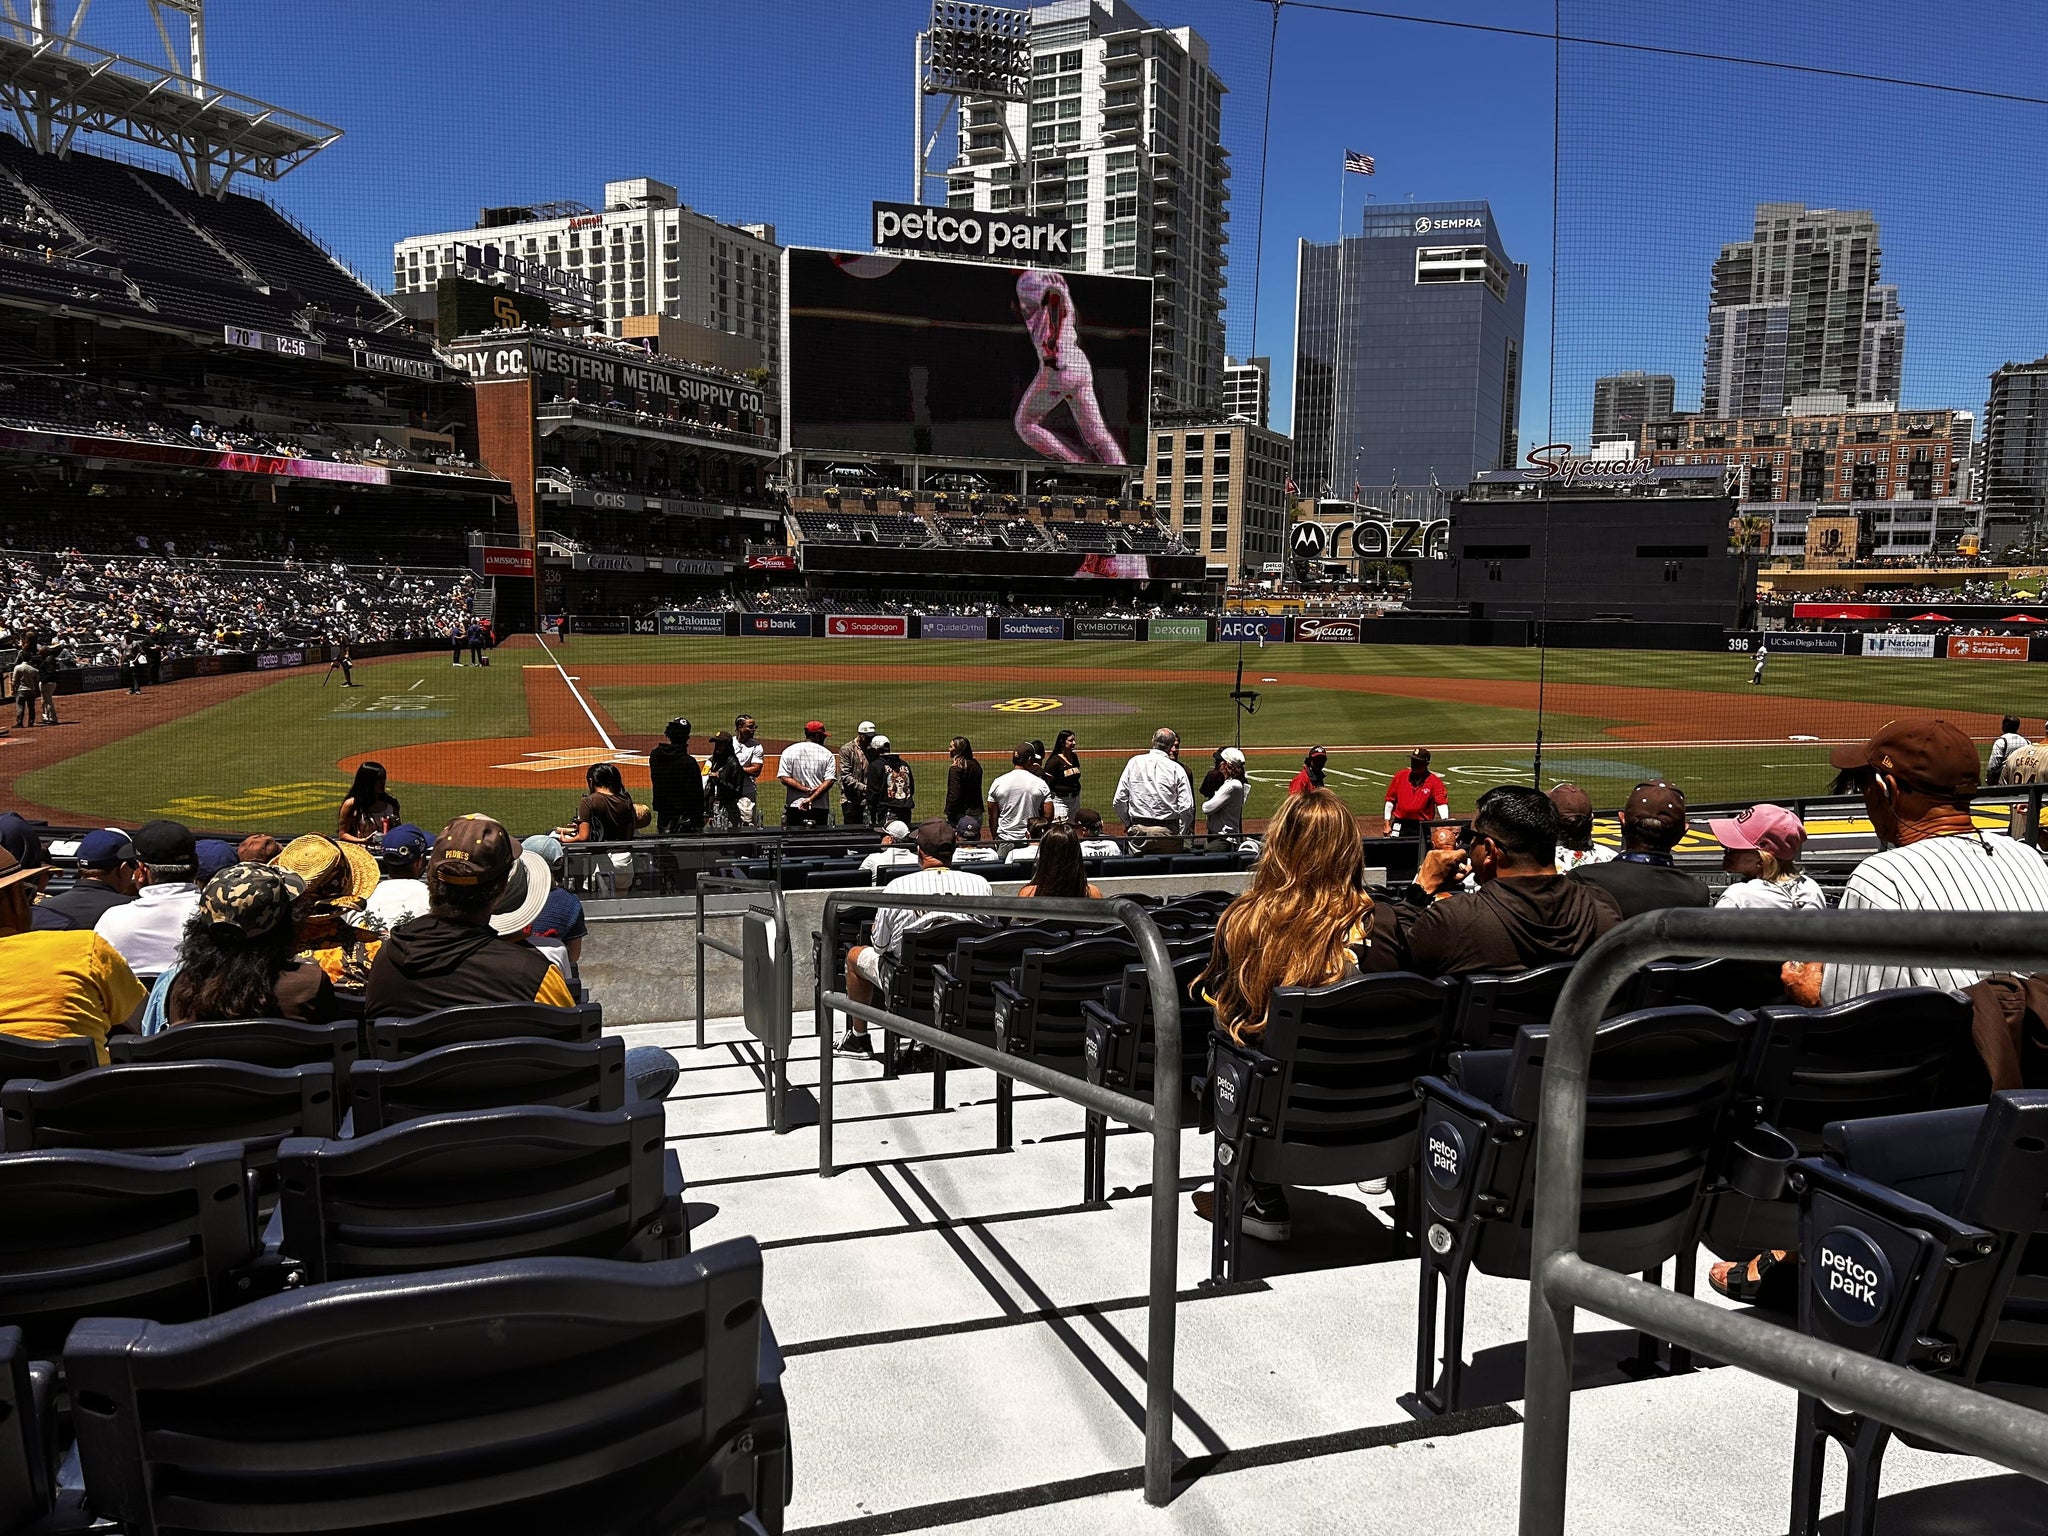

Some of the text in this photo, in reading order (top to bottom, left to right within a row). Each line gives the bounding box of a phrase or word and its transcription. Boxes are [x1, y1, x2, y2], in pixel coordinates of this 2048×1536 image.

[1434, 218, 1482, 229] SEMPRA
[877, 208, 1068, 255] petco park
[277, 337, 306, 356] 12:56
[365, 352, 434, 380] CUTWATER
[496, 349, 528, 375] CO.
[531, 346, 763, 413] WESTERN METAL SUPPLY CO.
[1522, 444, 1655, 488] Sycuan
[593, 492, 626, 508] ORIS
[1329, 519, 1450, 559] razr
[494, 556, 520, 565] MISSION
[520, 558, 532, 566] FED
[587, 554, 633, 571] Canel's
[675, 559, 715, 574] Canel's
[544, 569, 561, 582] 336
[634, 620, 655, 632] 342
[678, 614, 722, 626] Palomar
[756, 619, 796, 629] us bank
[851, 622, 898, 633] Snapdragon
[936, 622, 984, 632] QuidelOrtho
[1076, 622, 1133, 631] CYMBIOTIKA
[1004, 623, 1053, 634] Southwest
[1299, 620, 1354, 641] Sycuan
[1728, 638, 1749, 651] 396
[1770, 638, 1838, 648] UC San Diego Health
[1888, 639, 1930, 647] National
[1972, 646, 2021, 655] Safari Park
[2016, 757, 2039, 768] CEASE
[445, 850, 470, 861] PADRES
[1217, 1076, 1235, 1093] petco
[1220, 1088, 1234, 1103] park
[1429, 1137, 1458, 1161] petco
[1434, 1152, 1457, 1175] park
[1435, 1230, 1445, 1247] 15
[1821, 1247, 1878, 1287] petco
[1830, 1270, 1877, 1307] park
